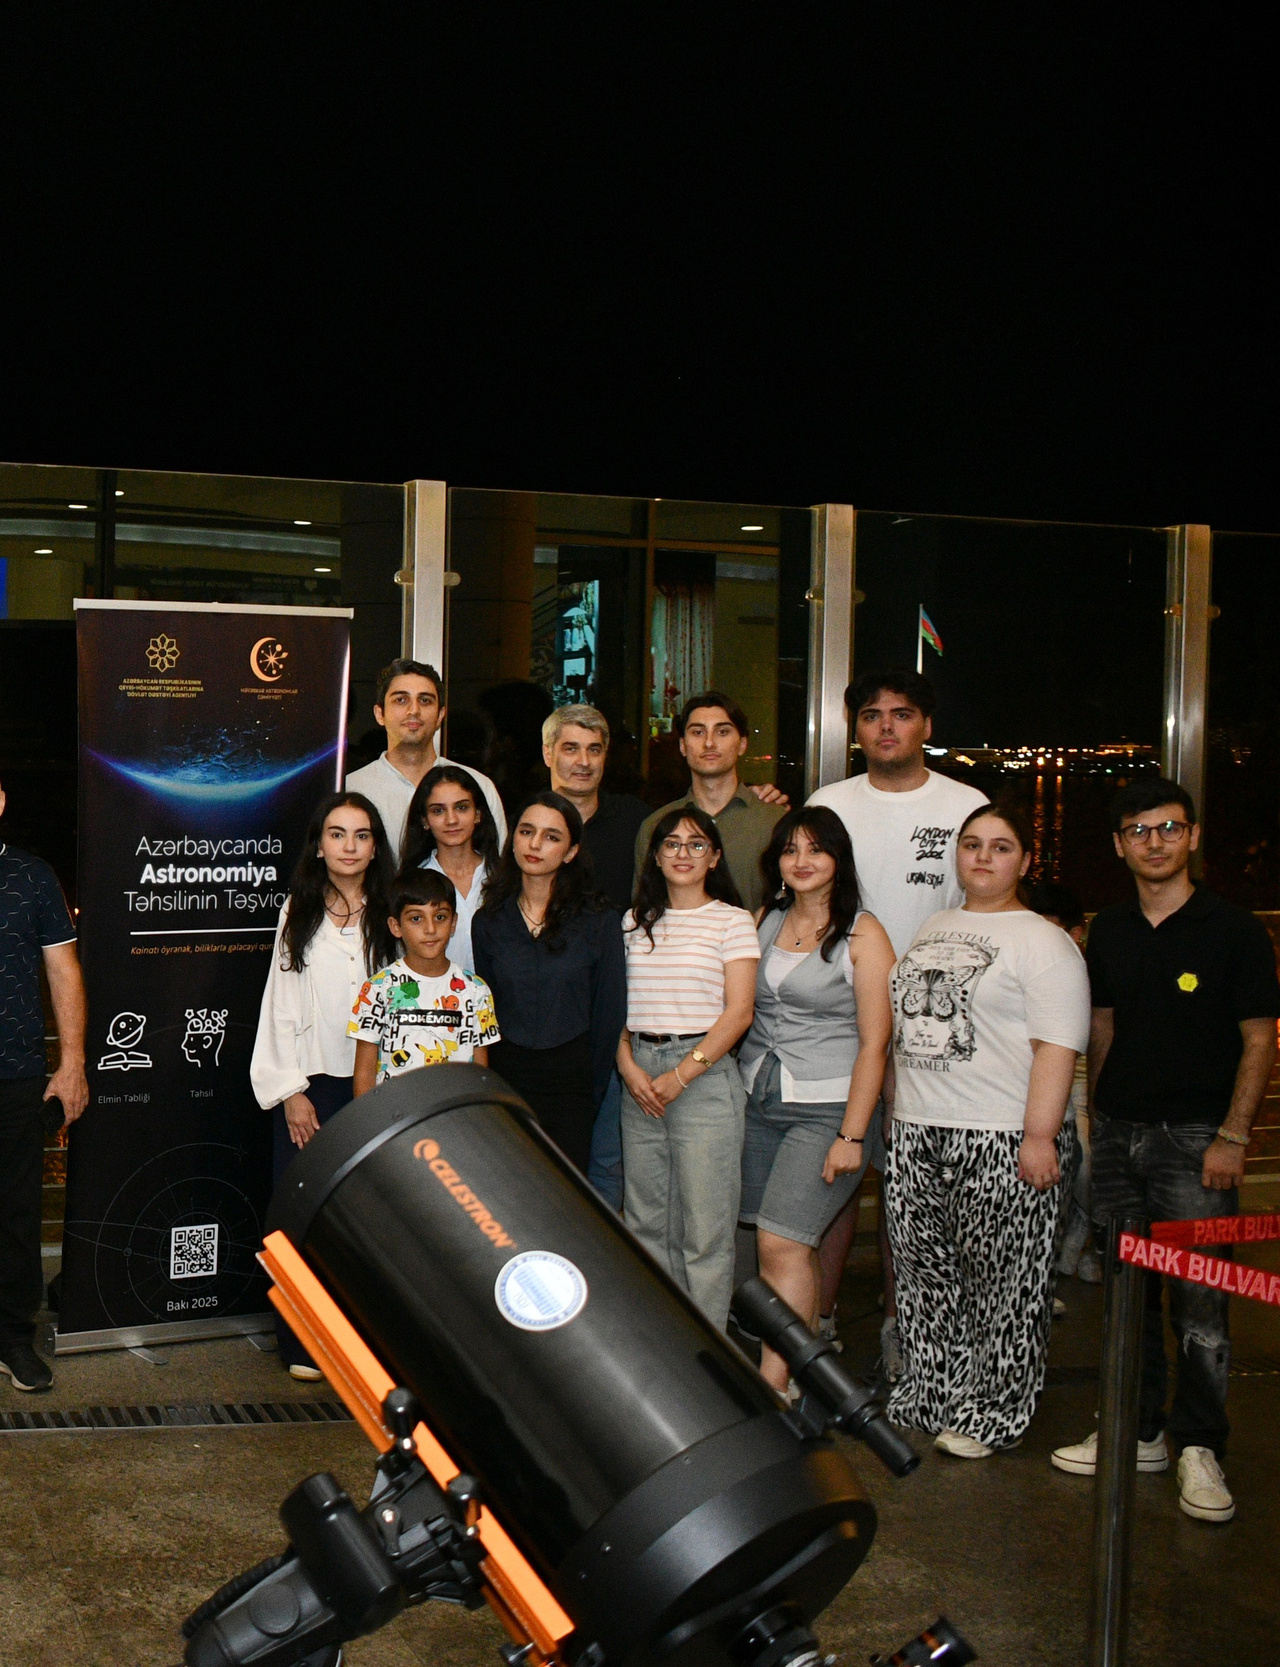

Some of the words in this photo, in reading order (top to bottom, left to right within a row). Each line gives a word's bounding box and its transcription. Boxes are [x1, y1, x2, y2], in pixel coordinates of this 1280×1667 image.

[910, 825, 955, 842] LONDON
[135, 834, 283, 861] Azərbaycanda
[919, 838, 938, 851] CITY
[139, 861, 277, 888] Astronomiya
[123, 889, 218, 912] Təhsilinin
[928, 931, 992, 944] CELESTIAL
[399, 1011, 460, 1025] POKÉMON
[898, 1056, 951, 1073] DREAMER
[97, 1094, 122, 1104] Elmin
[189, 1089, 214, 1098] Təhsil
[1194, 1218, 1241, 1244] PARK
[1244, 1215, 1280, 1240] BUL
[1120, 1234, 1183, 1276] PARK
[1187, 1252, 1280, 1306] BULVAR
[166, 1299, 189, 1312] Bakı
[191, 1296, 218, 1309] 2025
